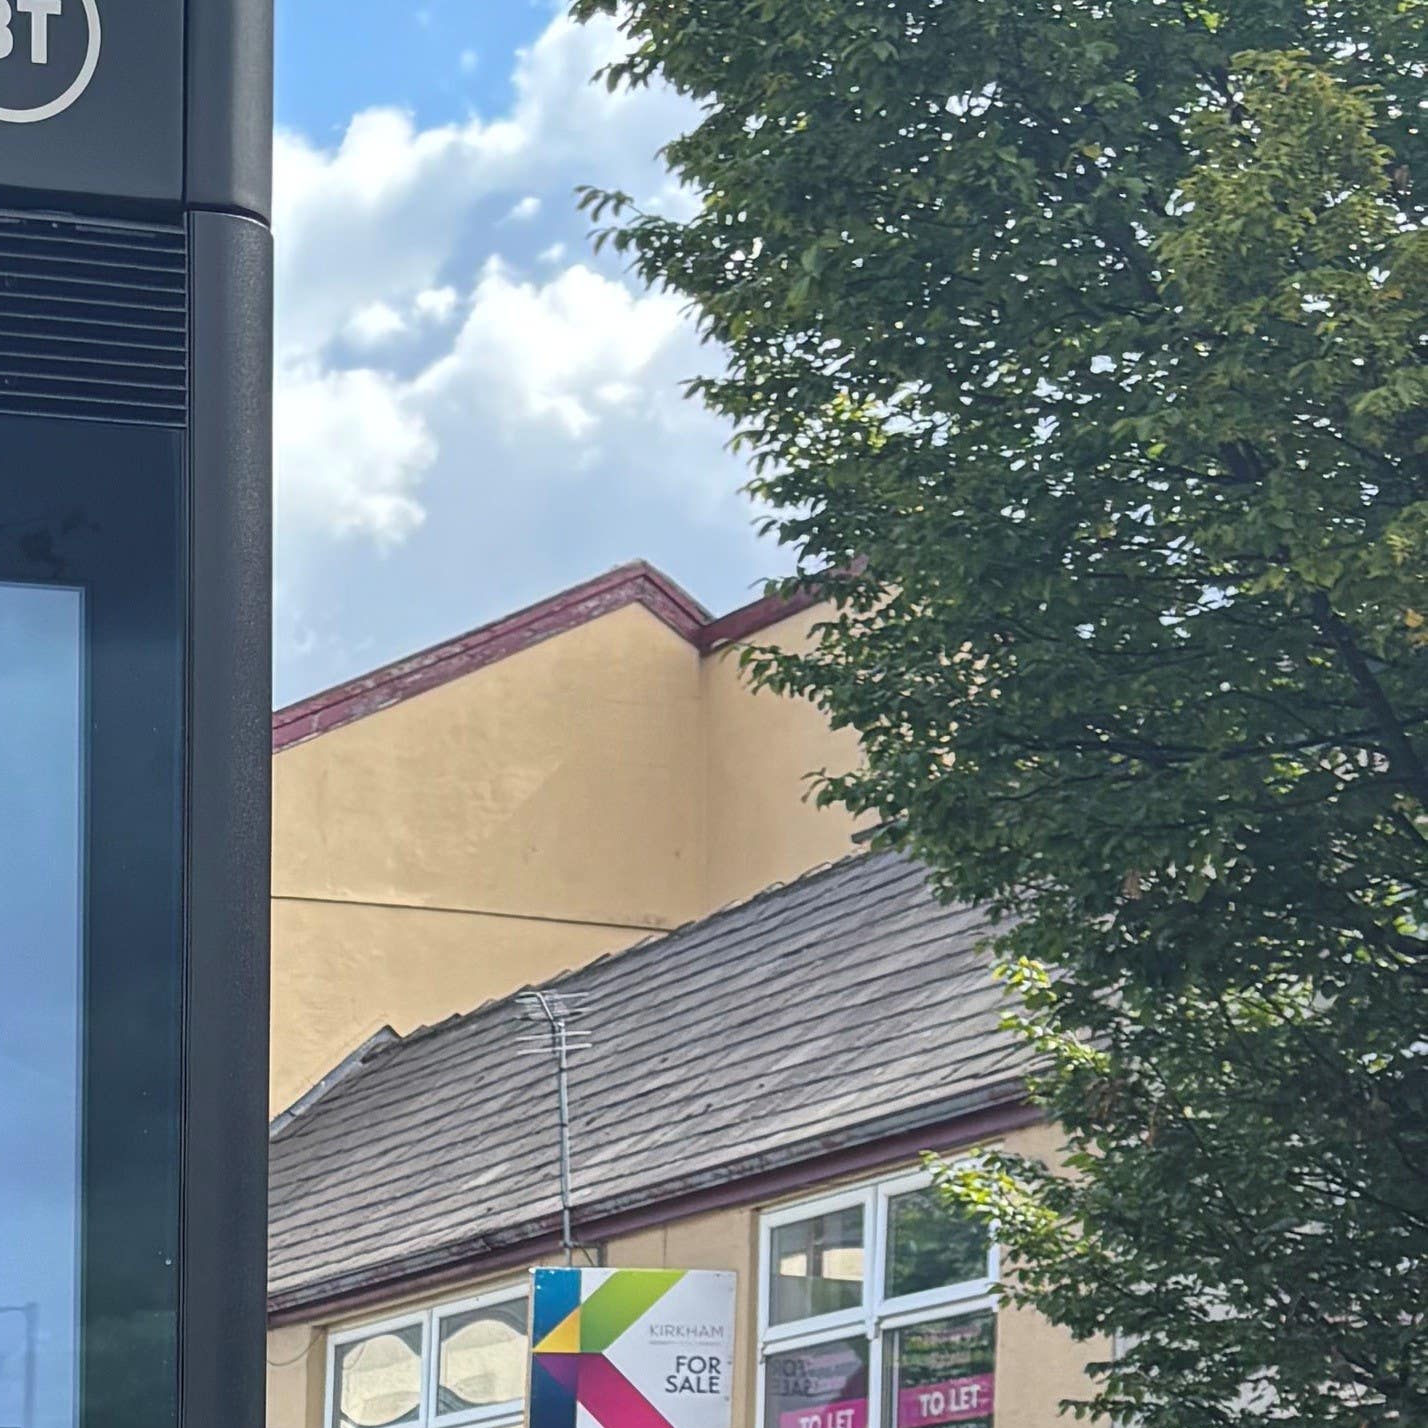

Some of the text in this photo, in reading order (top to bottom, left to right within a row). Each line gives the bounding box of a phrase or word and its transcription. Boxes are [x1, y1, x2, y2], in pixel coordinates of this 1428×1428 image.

[649, 1324, 724, 1339] KIRKHAM
[676, 1356, 721, 1375] FOR
[665, 1375, 720, 1394] SALE
[920, 1384, 981, 1418] TO LET
